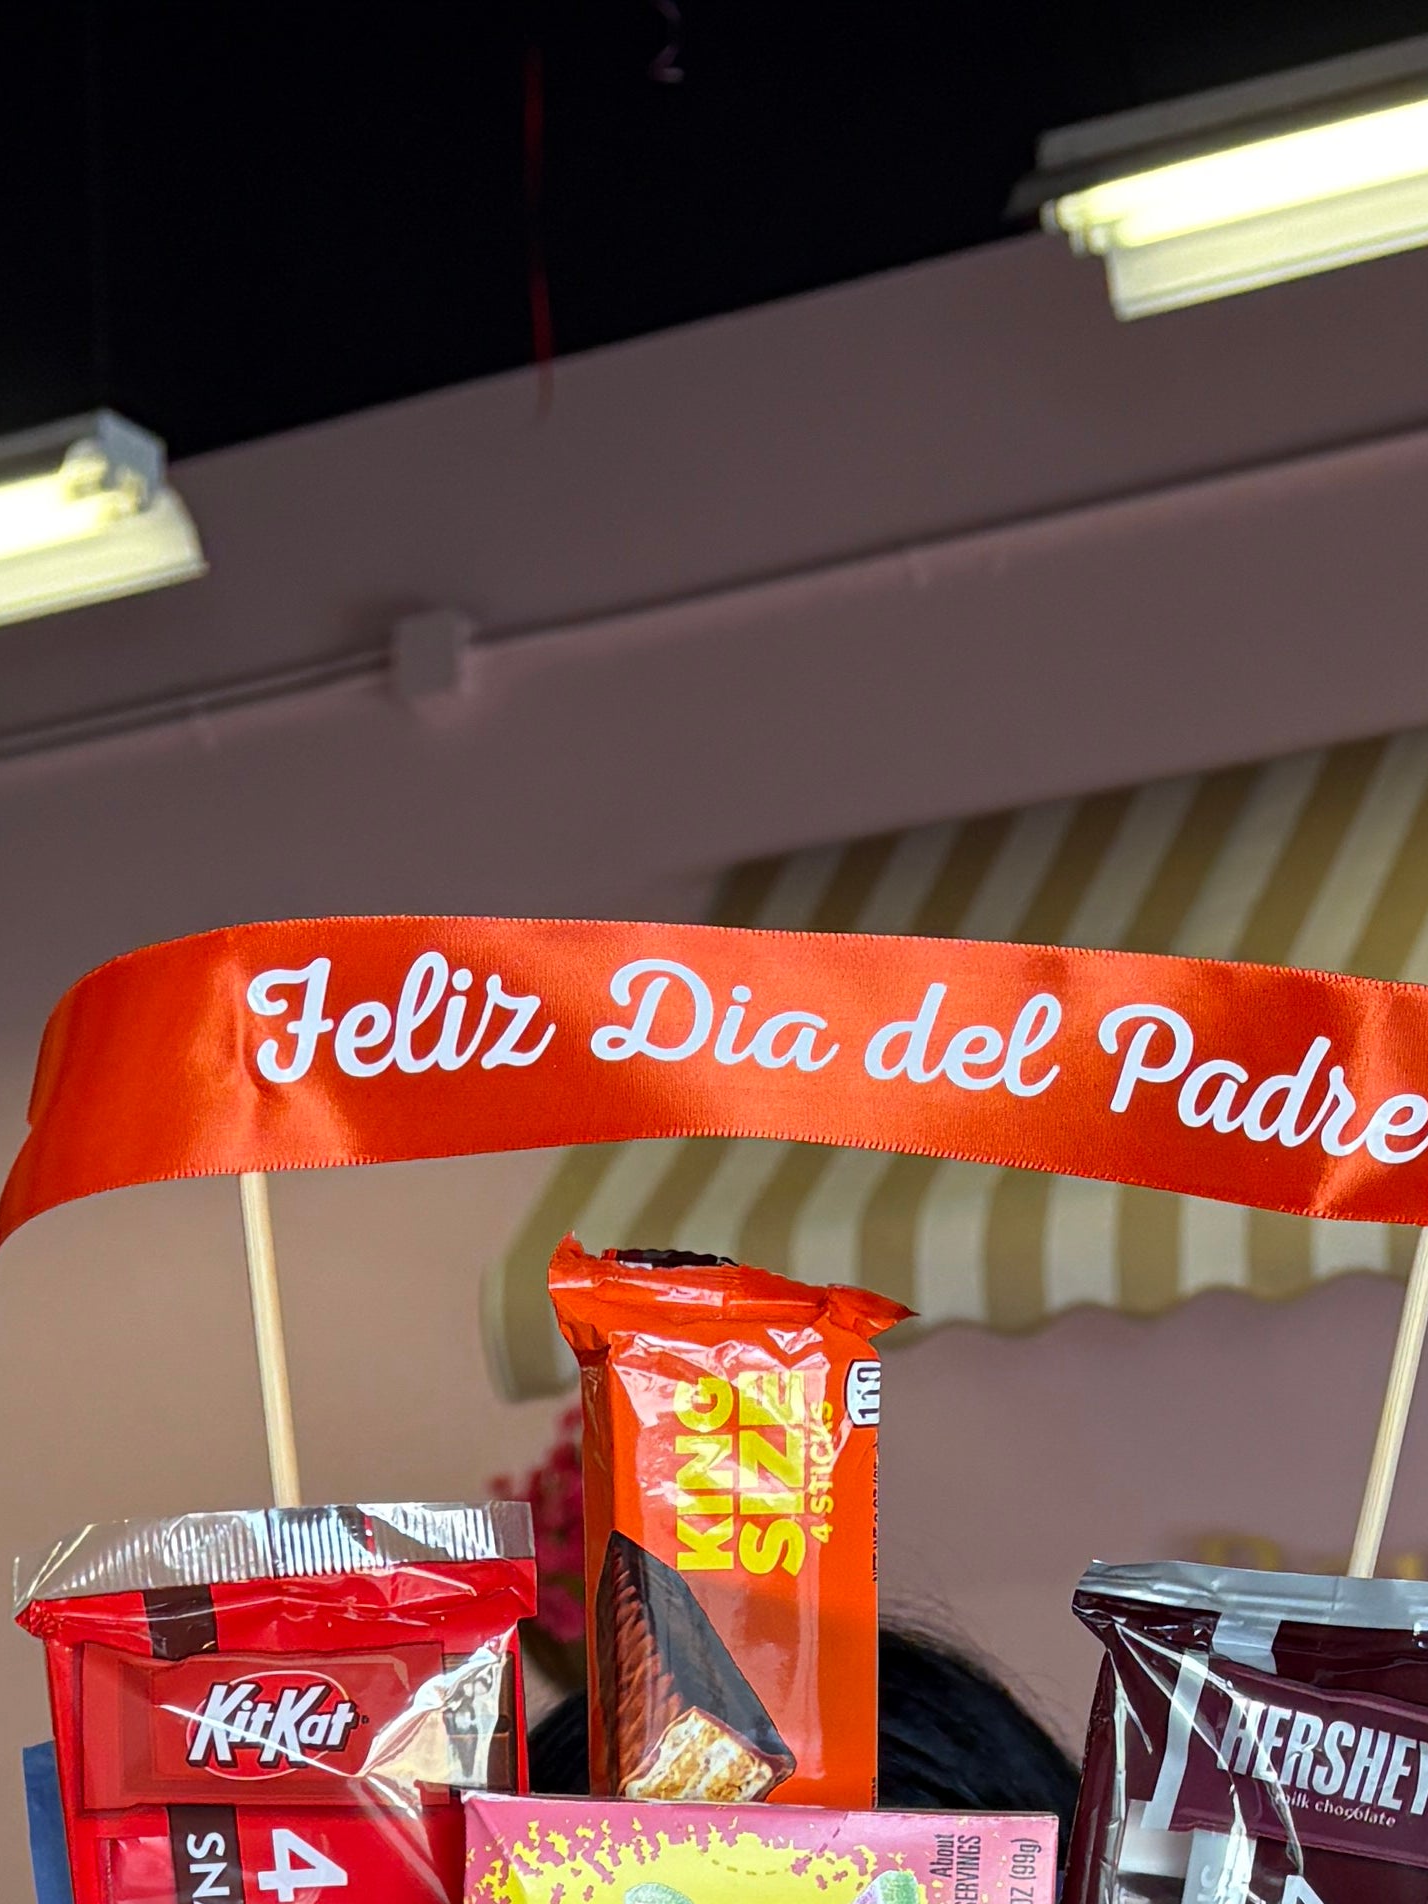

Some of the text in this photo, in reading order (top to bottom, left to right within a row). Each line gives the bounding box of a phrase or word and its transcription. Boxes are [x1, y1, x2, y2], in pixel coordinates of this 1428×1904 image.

[246, 950, 558, 1086] Feliz
[590, 958, 843, 1071] Dia
[864, 983, 1064, 1099] del
[676, 1375, 735, 1571] KING
[738, 1369, 807, 1577] SIZE
[809, 1401, 834, 1543] 4 STICKS
[186, 1681, 359, 1769] KitKat
[930, 1833, 956, 1879] About
[1314, 1797, 1397, 1829] chocolate
[258, 1827, 348, 1902] 4
[1011, 1838, 1042, 1883] (99g)
